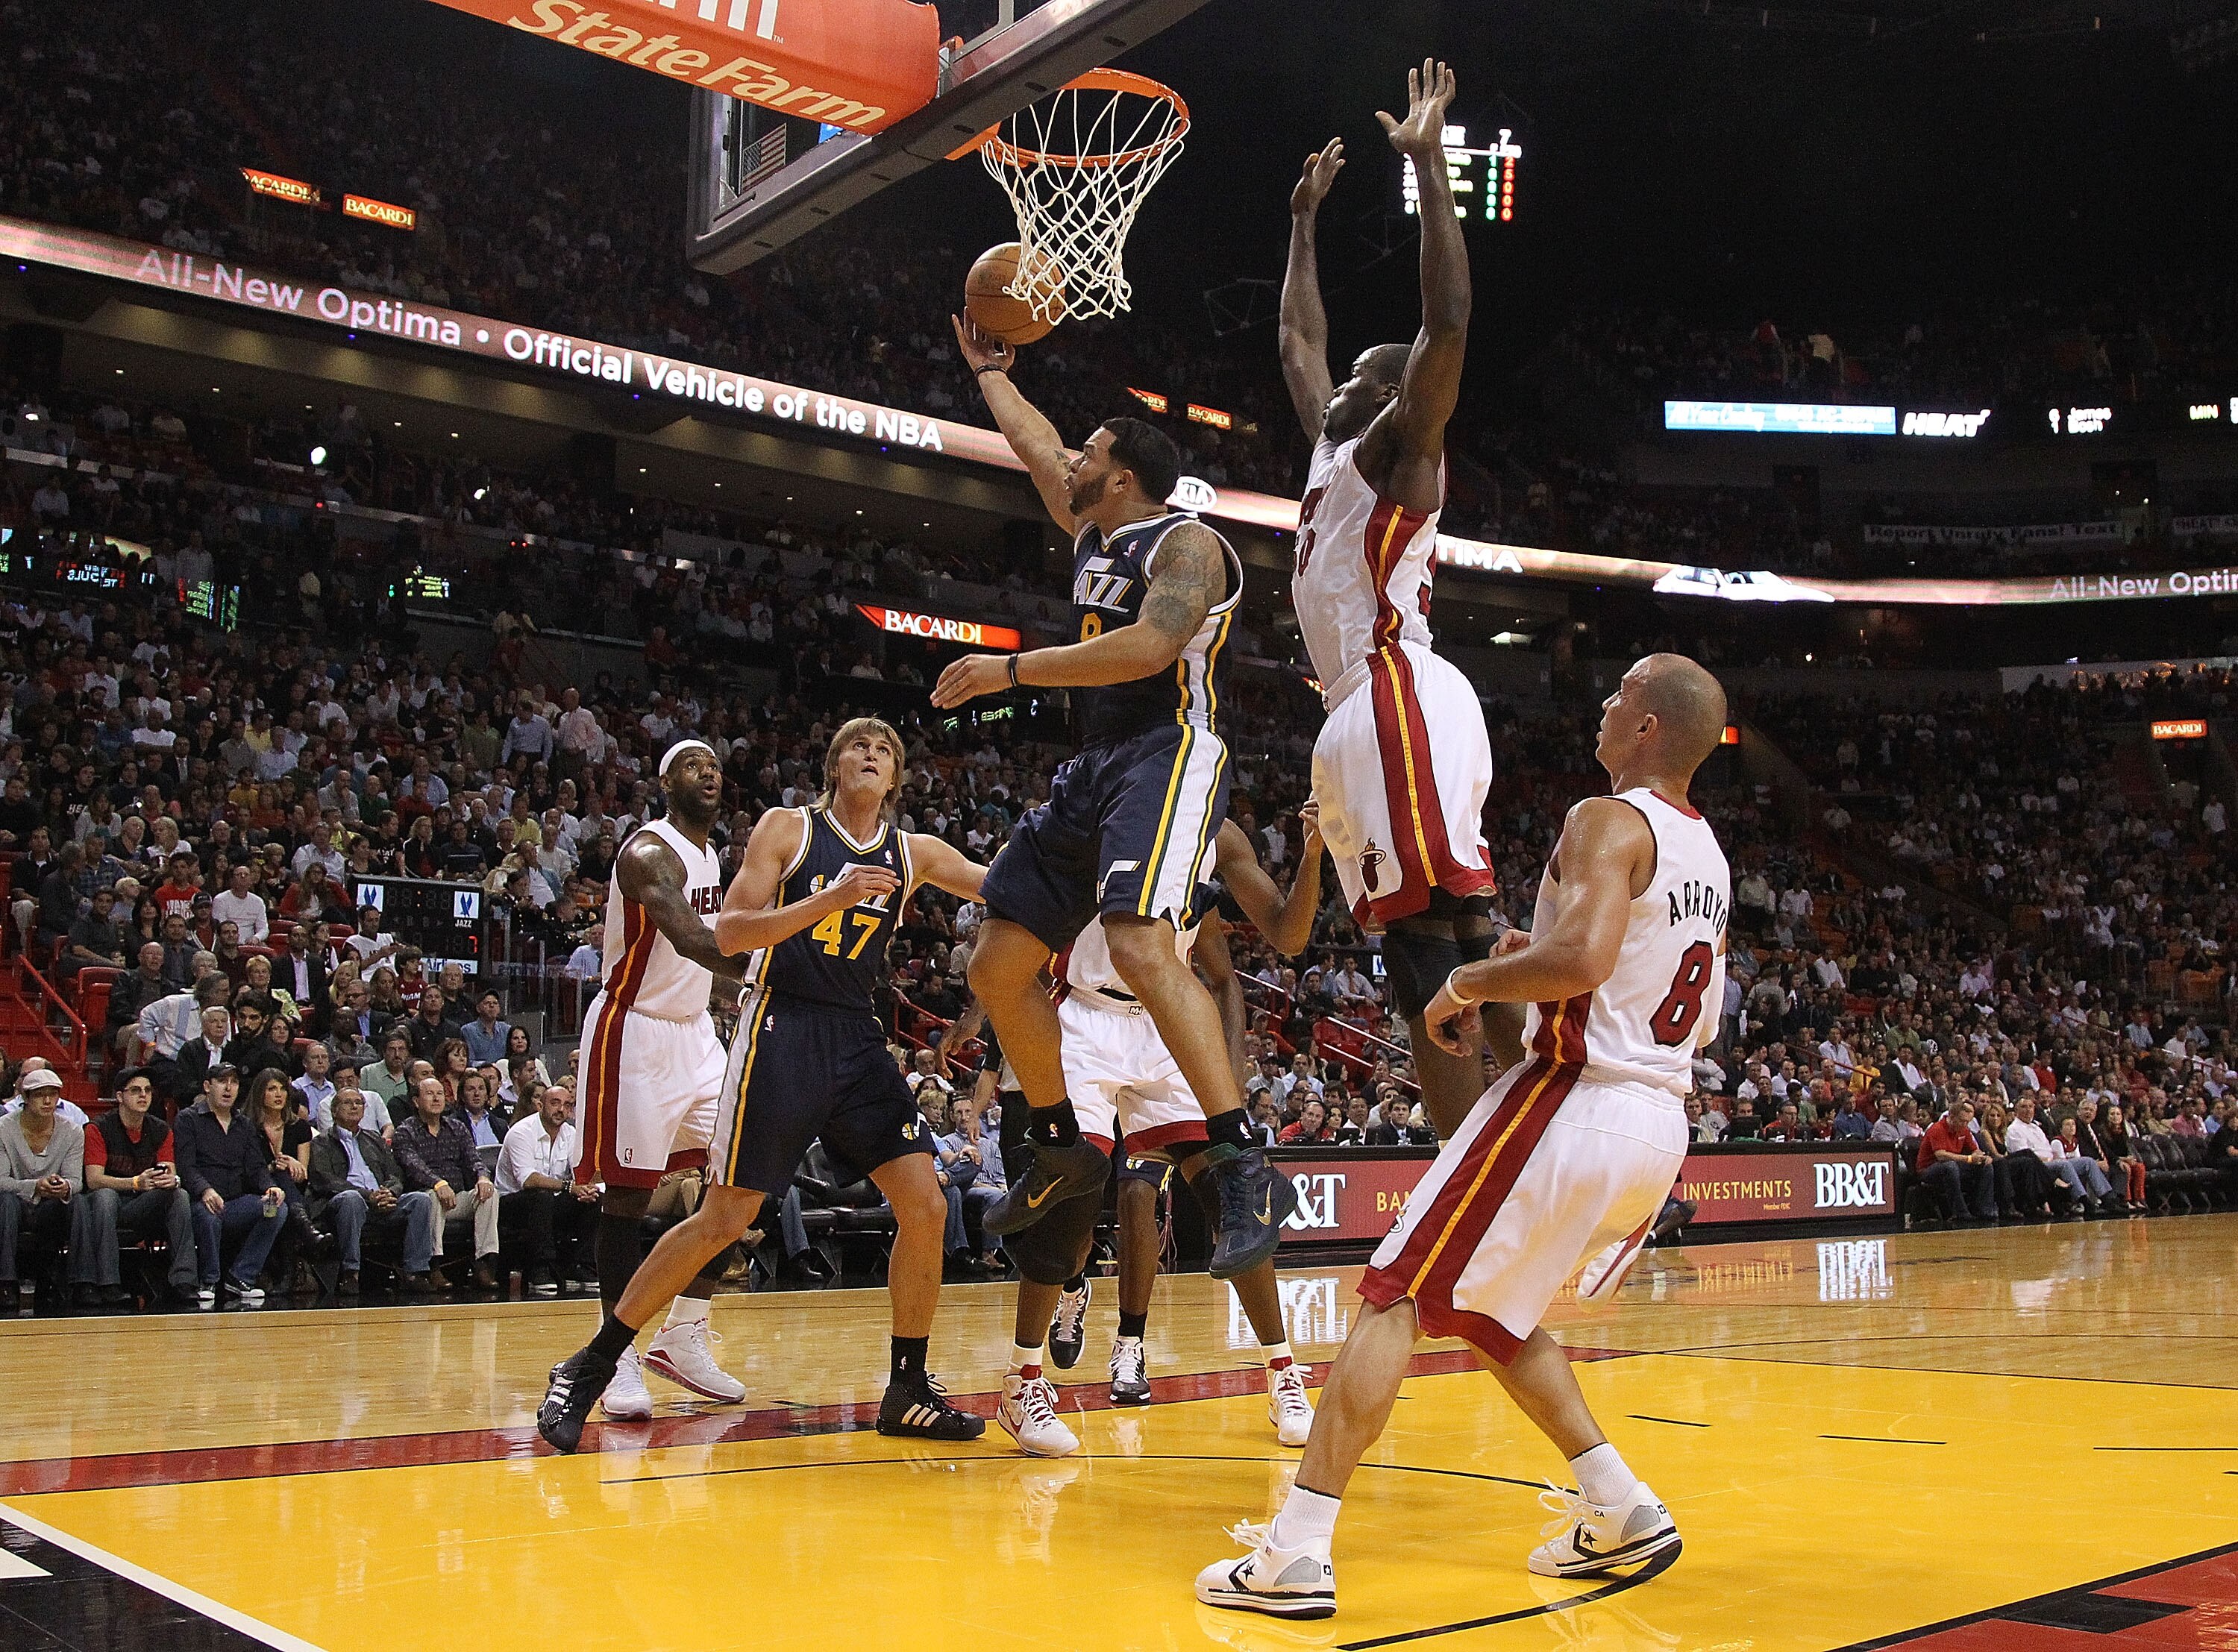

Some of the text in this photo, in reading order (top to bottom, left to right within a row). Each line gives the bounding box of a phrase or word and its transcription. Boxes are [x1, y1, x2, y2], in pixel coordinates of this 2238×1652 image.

[508, 0, 710, 78] State
[697, 57, 886, 127] Farm
[345, 198, 413, 227] BACARDI
[136, 249, 944, 452] All-New Optima Official Vehicle of the NBA
[1902, 409, 1991, 436] HEAT
[2190, 404, 2219, 420] MIN
[1175, 482, 1211, 505] KIA
[2051, 574, 2160, 597] All-New
[885, 609, 983, 645] BACARDI
[2153, 723, 2203, 735] BACARDI
[1667, 879, 1726, 938] ARROYO
[454, 919, 472, 928] JAZZ
[812, 909, 882, 961] 47
[1649, 940, 1714, 1047] 8
[1683, 1180, 1791, 1201] INVESTMENTS
[1813, 1161, 1890, 1208] BB&T
[1594, 1510, 1605, 1518] CA
